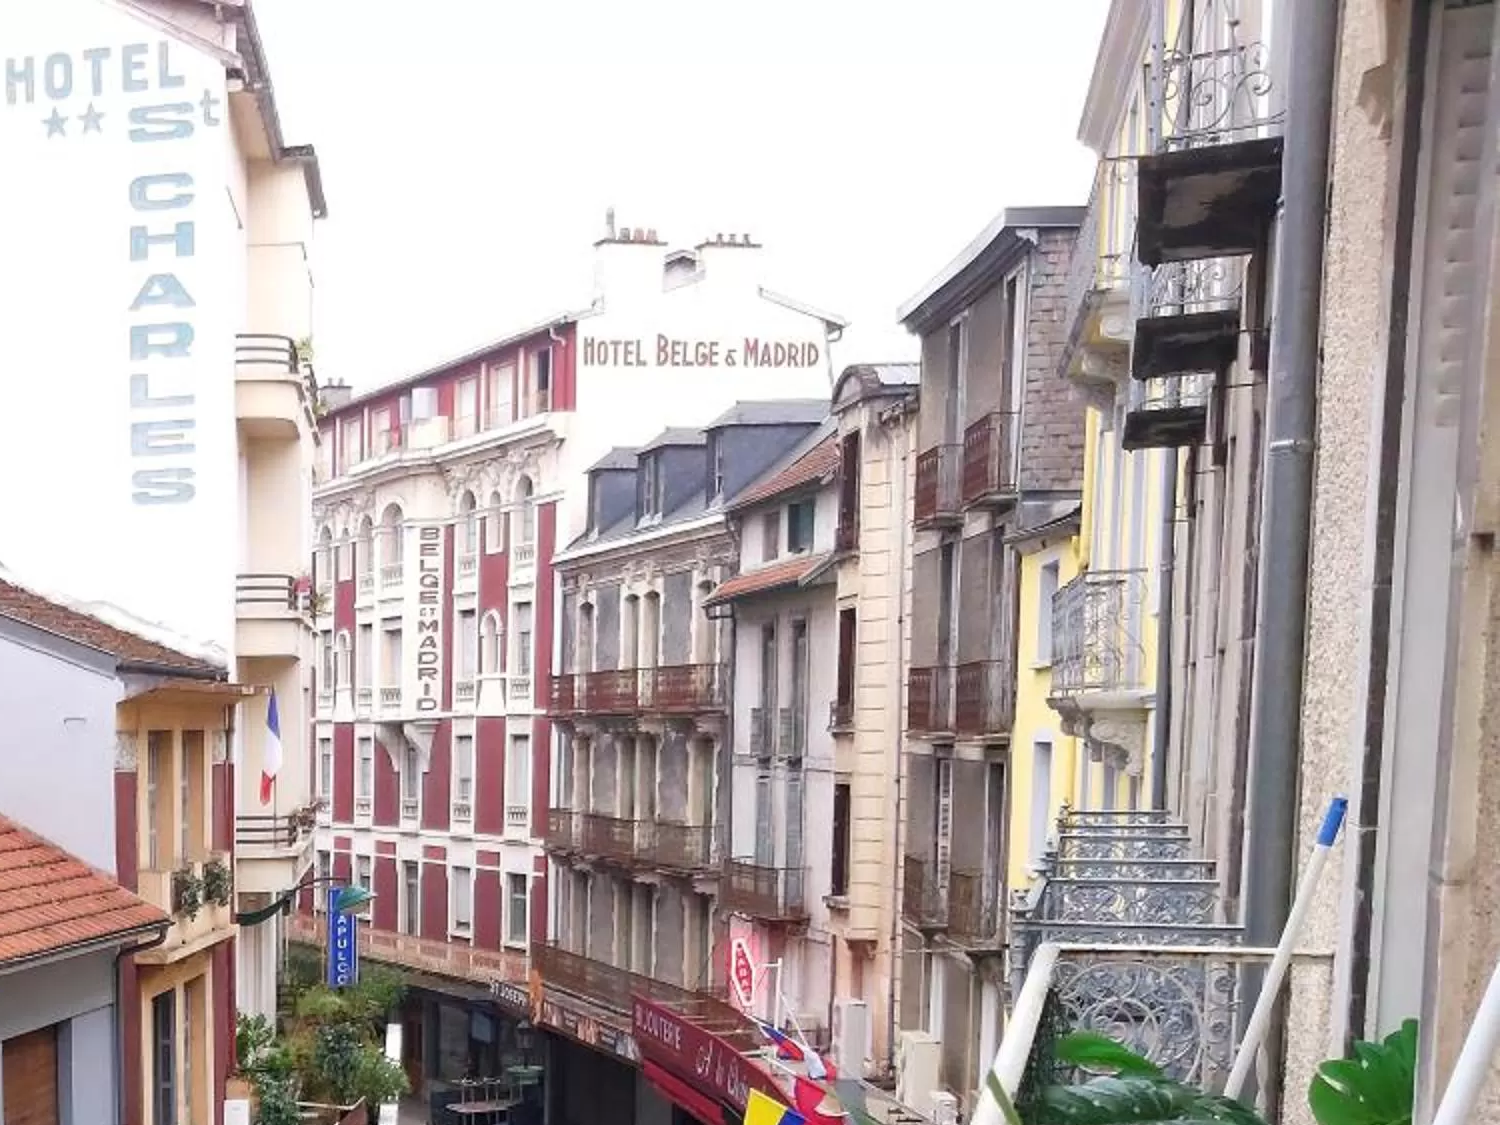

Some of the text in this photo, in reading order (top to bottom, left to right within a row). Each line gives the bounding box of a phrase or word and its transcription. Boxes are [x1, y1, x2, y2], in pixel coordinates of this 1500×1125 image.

[6, 41, 184, 105] HOTEL
[128, 172, 196, 505] CHARLES
[582, 336, 648, 367] HOTEL
[656, 333, 719, 367] BELGE
[744, 337, 819, 368] MADRID
[419, 527, 440, 604] BELGE
[416, 620, 439, 711] MADRID
